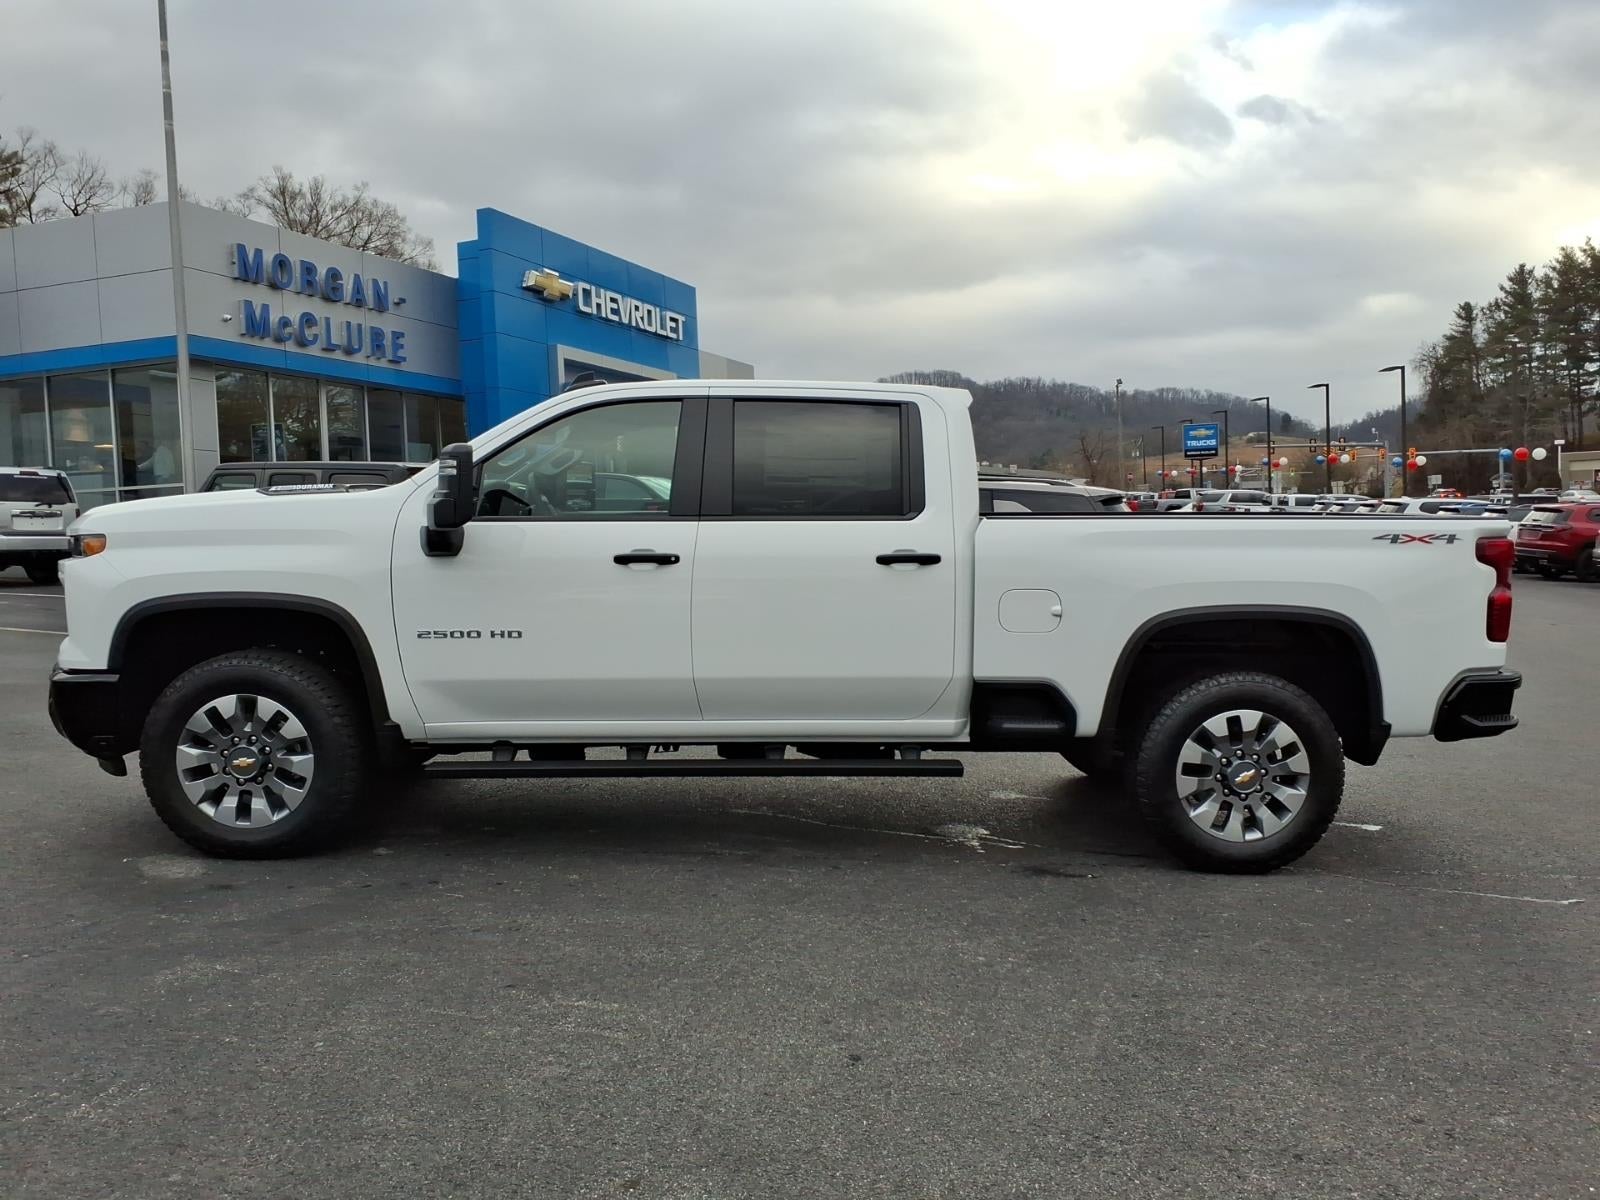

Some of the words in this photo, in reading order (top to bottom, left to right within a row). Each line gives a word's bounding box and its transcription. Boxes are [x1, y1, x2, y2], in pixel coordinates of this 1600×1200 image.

[576, 282, 686, 341] CHEVROLET
[240, 299, 407, 363] McCLURE
[1186, 439, 1217, 447] TRUCKS
[417, 629, 482, 639] 2500
[490, 629, 522, 639] HD
